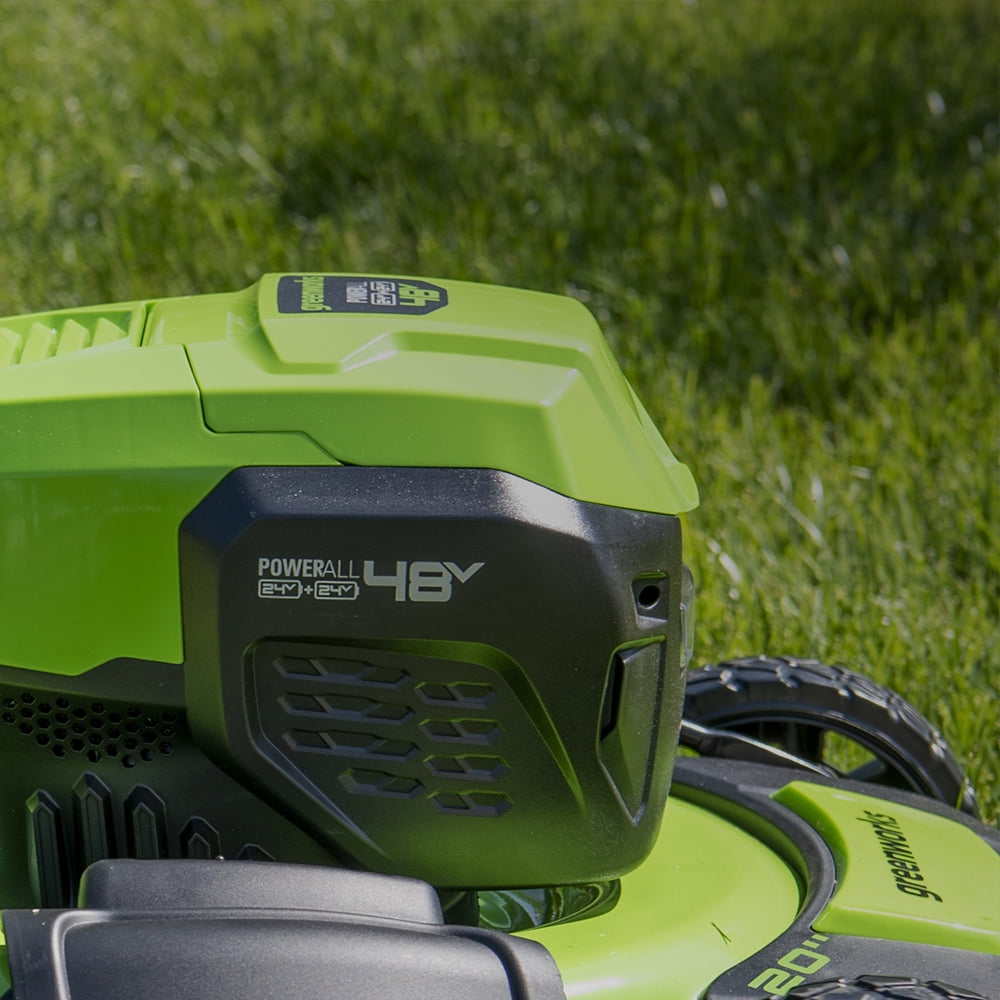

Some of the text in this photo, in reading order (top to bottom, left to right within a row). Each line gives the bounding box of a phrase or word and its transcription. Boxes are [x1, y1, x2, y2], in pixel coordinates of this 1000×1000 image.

[398, 282, 441, 307] 48V
[258, 558, 360, 578] POWERALL
[363, 560, 486, 602] 48V
[856, 810, 943, 903] greenworks
